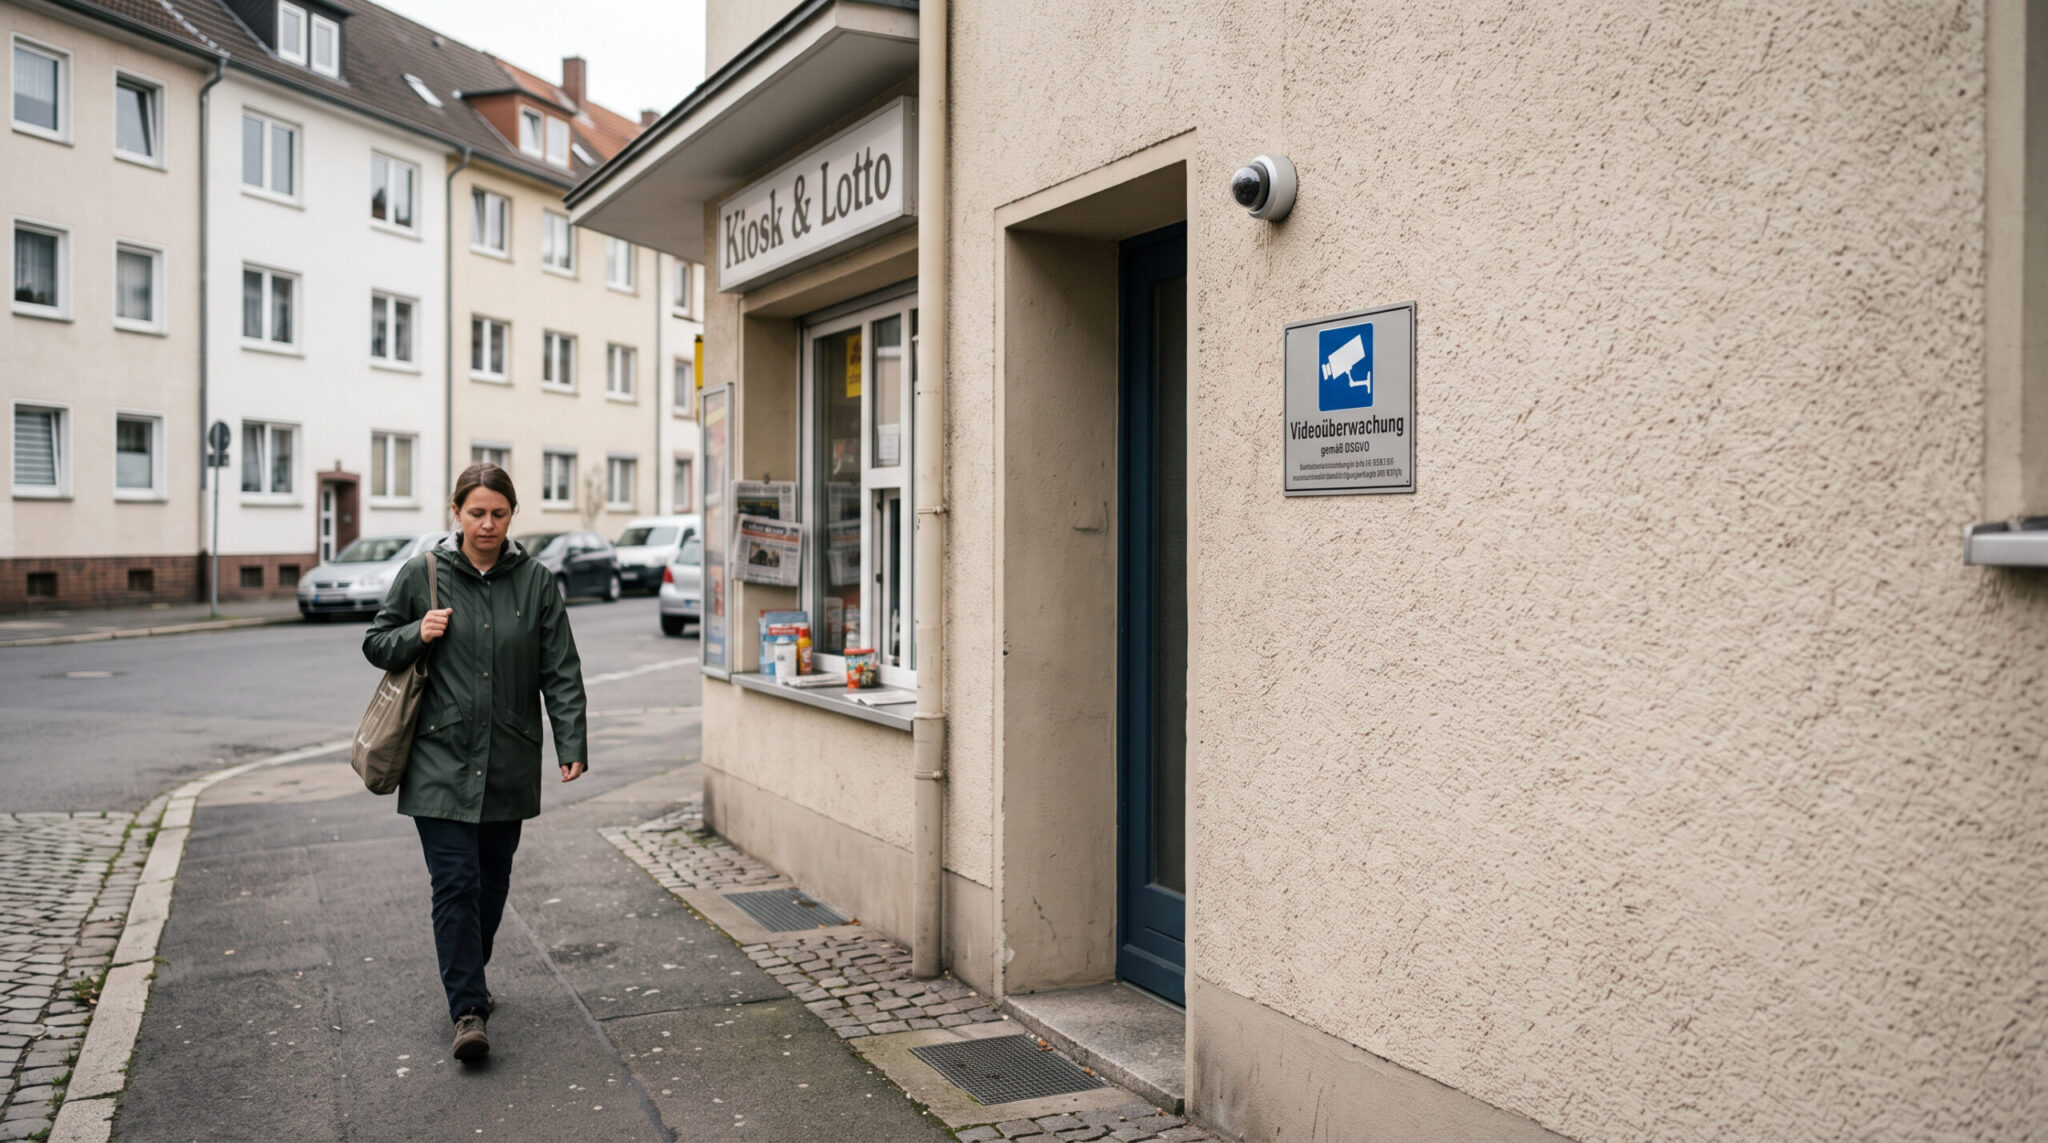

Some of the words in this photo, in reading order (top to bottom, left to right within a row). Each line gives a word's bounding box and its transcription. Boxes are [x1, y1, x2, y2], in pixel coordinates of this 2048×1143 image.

[725, 188, 784, 269] Kiosk
[791, 174, 812, 239] &
[820, 146, 892, 226] Lotto
[1290, 414, 1404, 440] Videoüberwachung
[1345, 441, 1370, 453] DSGVO
